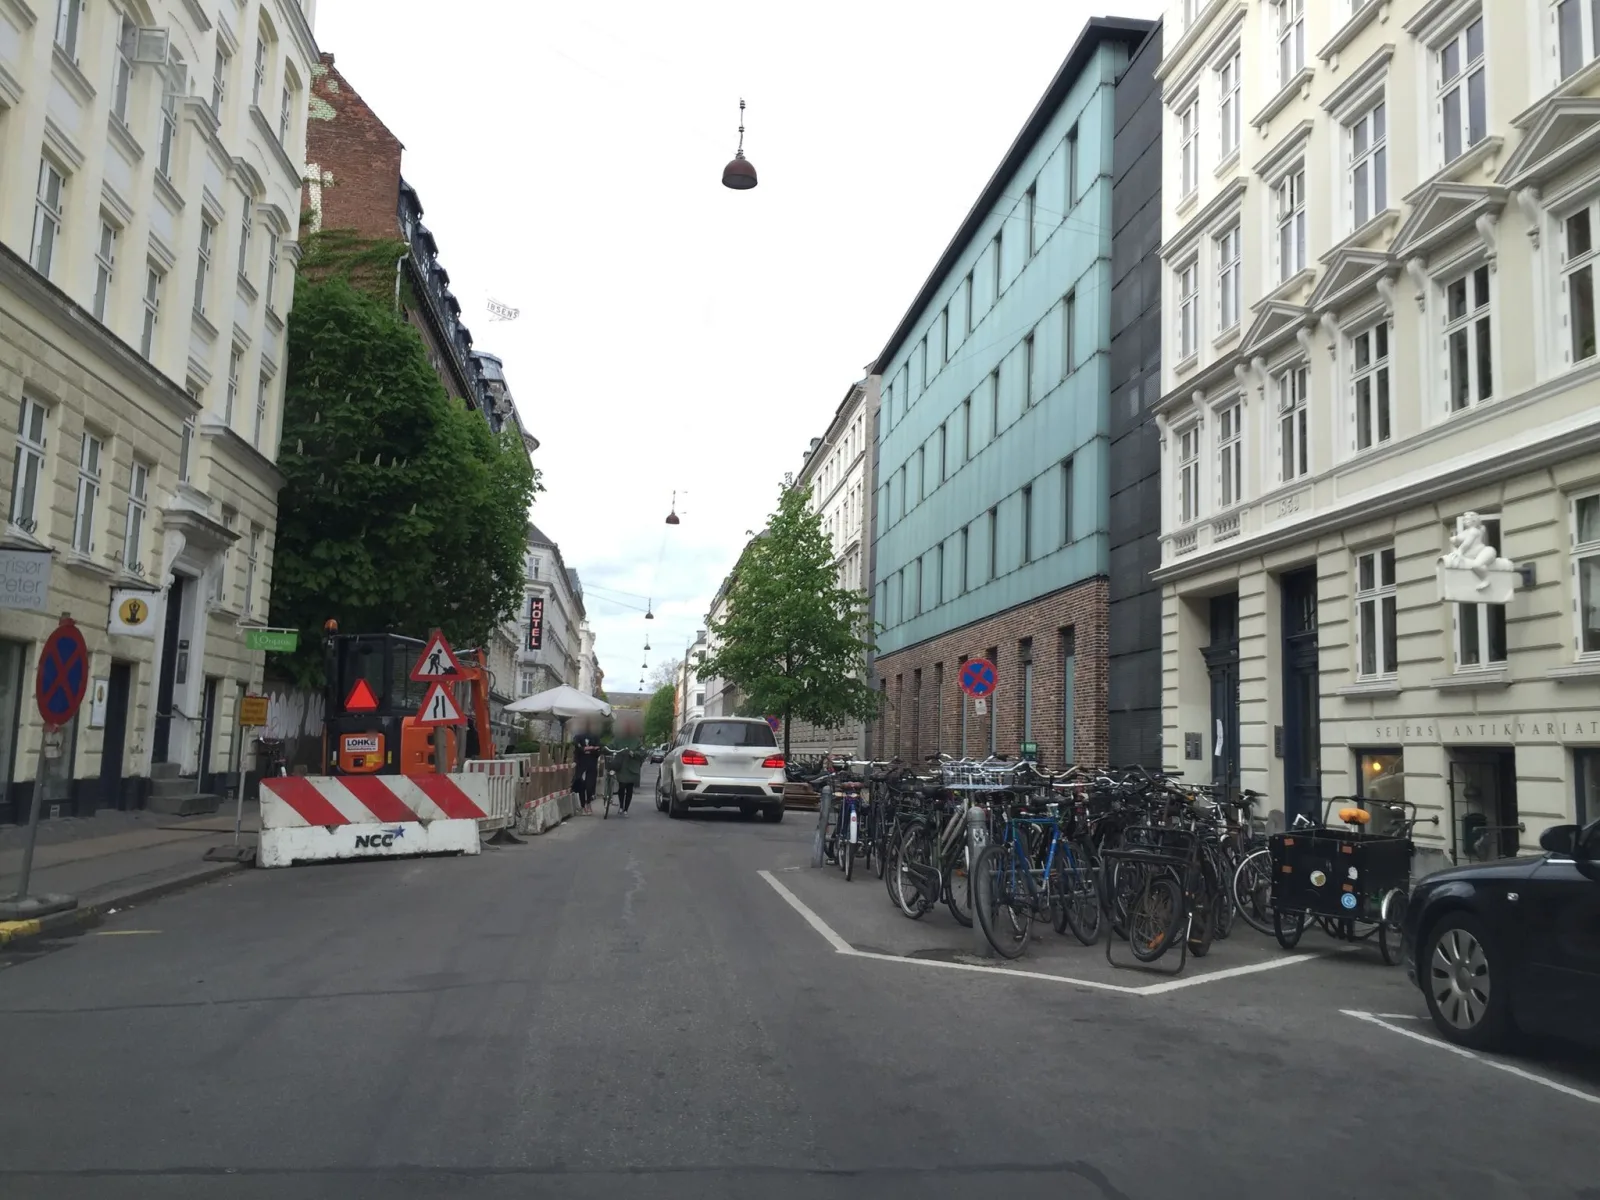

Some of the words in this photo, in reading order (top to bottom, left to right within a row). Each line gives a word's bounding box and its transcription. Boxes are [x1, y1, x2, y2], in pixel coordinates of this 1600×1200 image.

[486, 301, 519, 319] IBSENS
[0, 557, 45, 575] risør
[531, 601, 542, 646] HOTEL
[1376, 725, 1433, 738] SEIERS
[1453, 721, 1598, 737] ANTIKVARIAT
[354, 833, 394, 849] NCC
